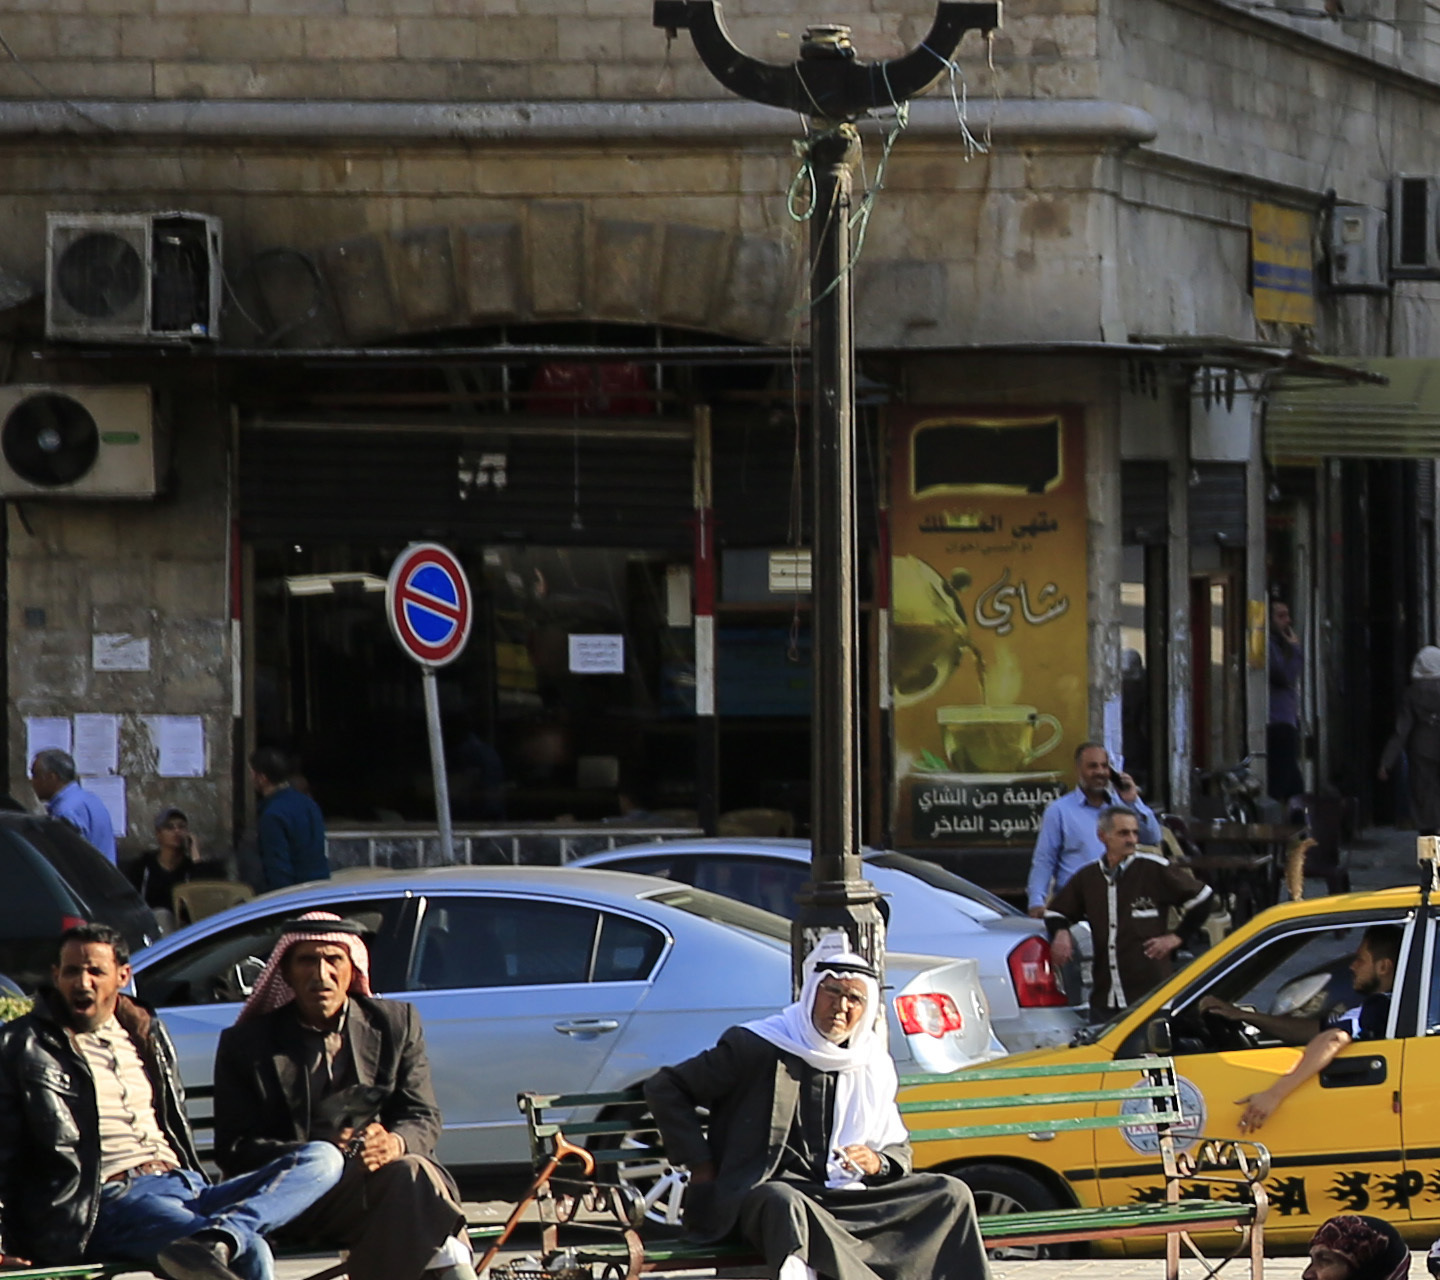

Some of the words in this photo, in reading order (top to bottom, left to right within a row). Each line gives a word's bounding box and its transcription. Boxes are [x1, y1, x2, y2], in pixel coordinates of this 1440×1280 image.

[975, 567, 1070, 637] شاي
[918, 786, 967, 812] الشاي
[972, 788, 998, 809] من
[1003, 785, 1061, 809] توليفة
[930, 815, 984, 838] الفاخر
